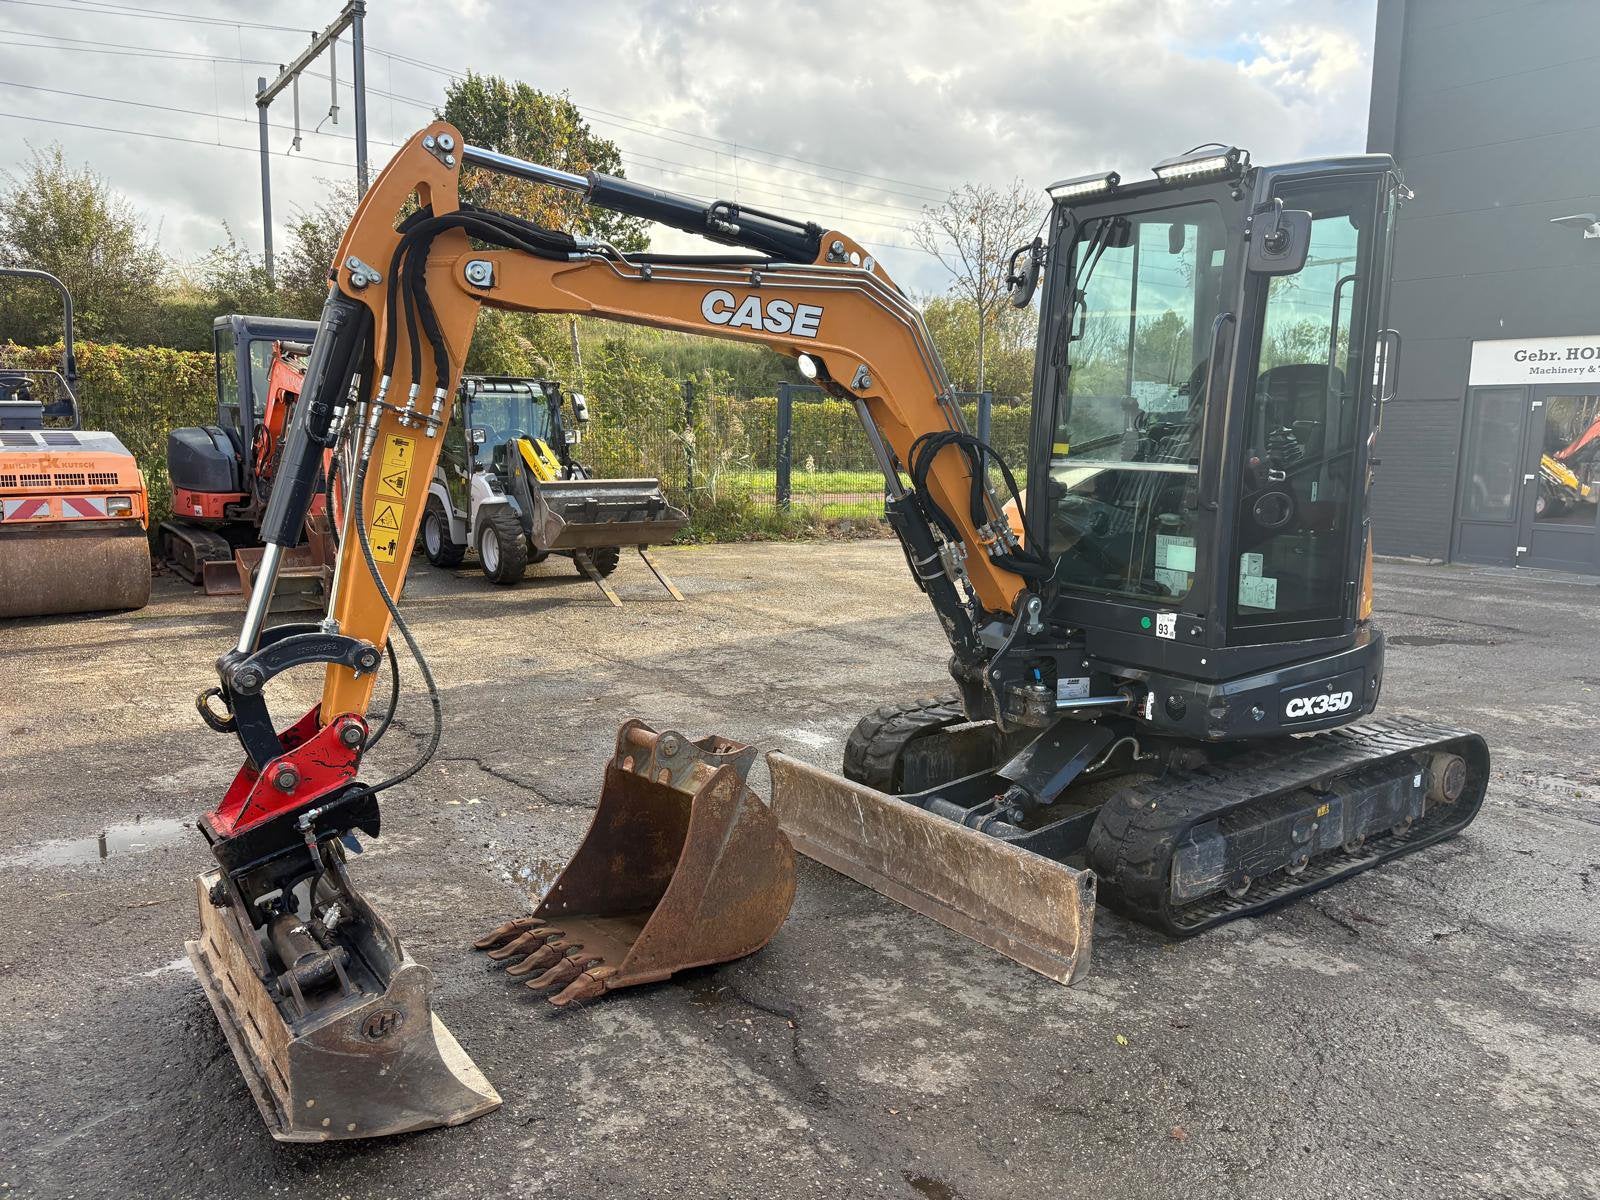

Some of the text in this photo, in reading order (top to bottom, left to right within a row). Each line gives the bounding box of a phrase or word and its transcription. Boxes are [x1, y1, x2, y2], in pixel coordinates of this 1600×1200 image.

[701, 288, 824, 338] CASE
[1514, 349, 1561, 362] Gebr.
[1529, 366, 1585, 375] Machinery
[1588, 365, 1596, 373] &
[1159, 624, 1168, 635] 93
[1286, 691, 1353, 717] CX35D
